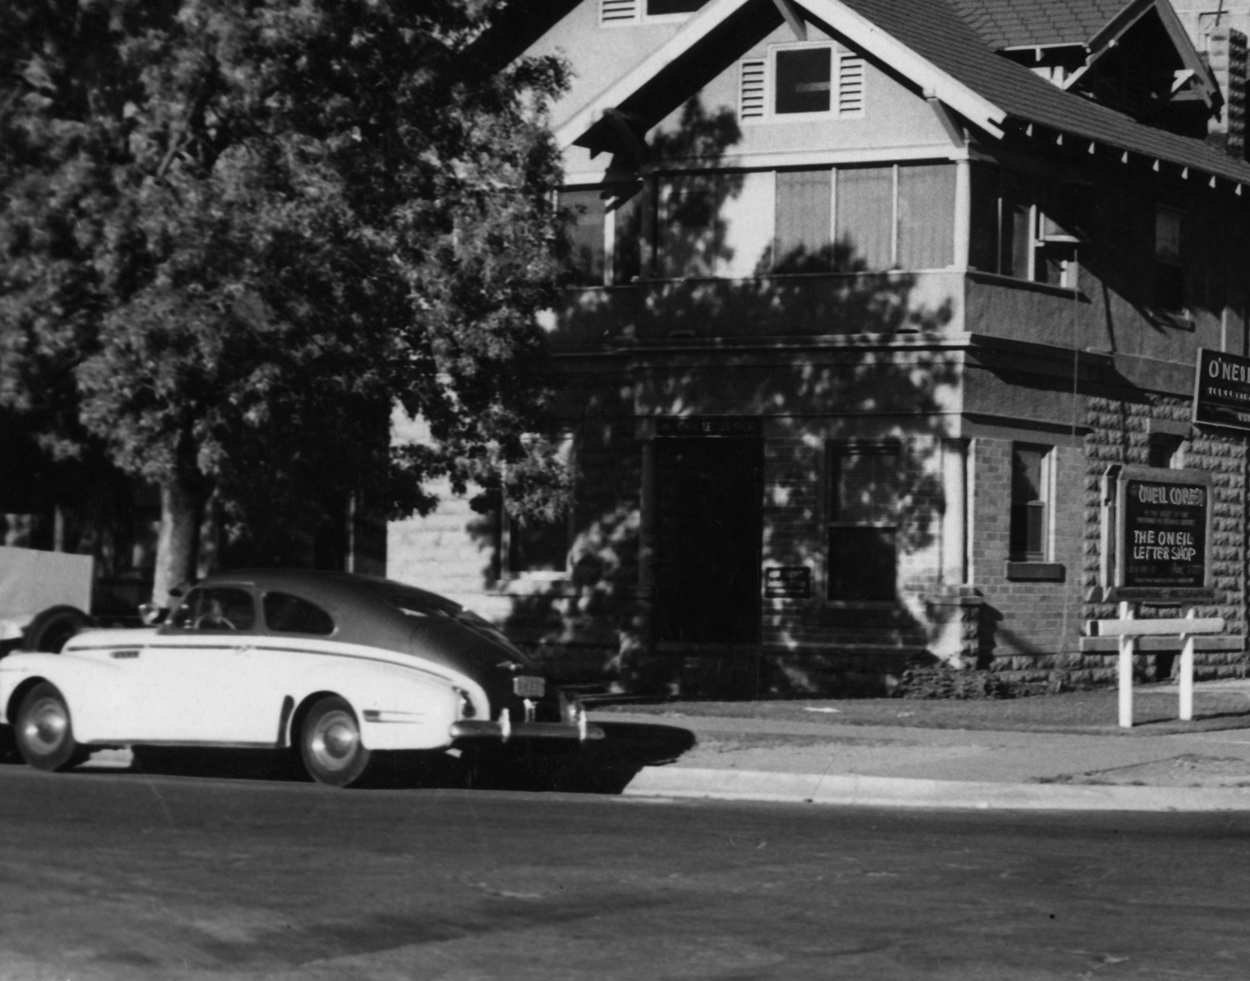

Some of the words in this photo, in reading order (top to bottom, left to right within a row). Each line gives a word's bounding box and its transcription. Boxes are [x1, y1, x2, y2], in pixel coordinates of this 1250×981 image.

[1134, 530, 1155, 544] THE
[1133, 546, 1170, 561] LETTER
[1171, 544, 1197, 562] SHOP
